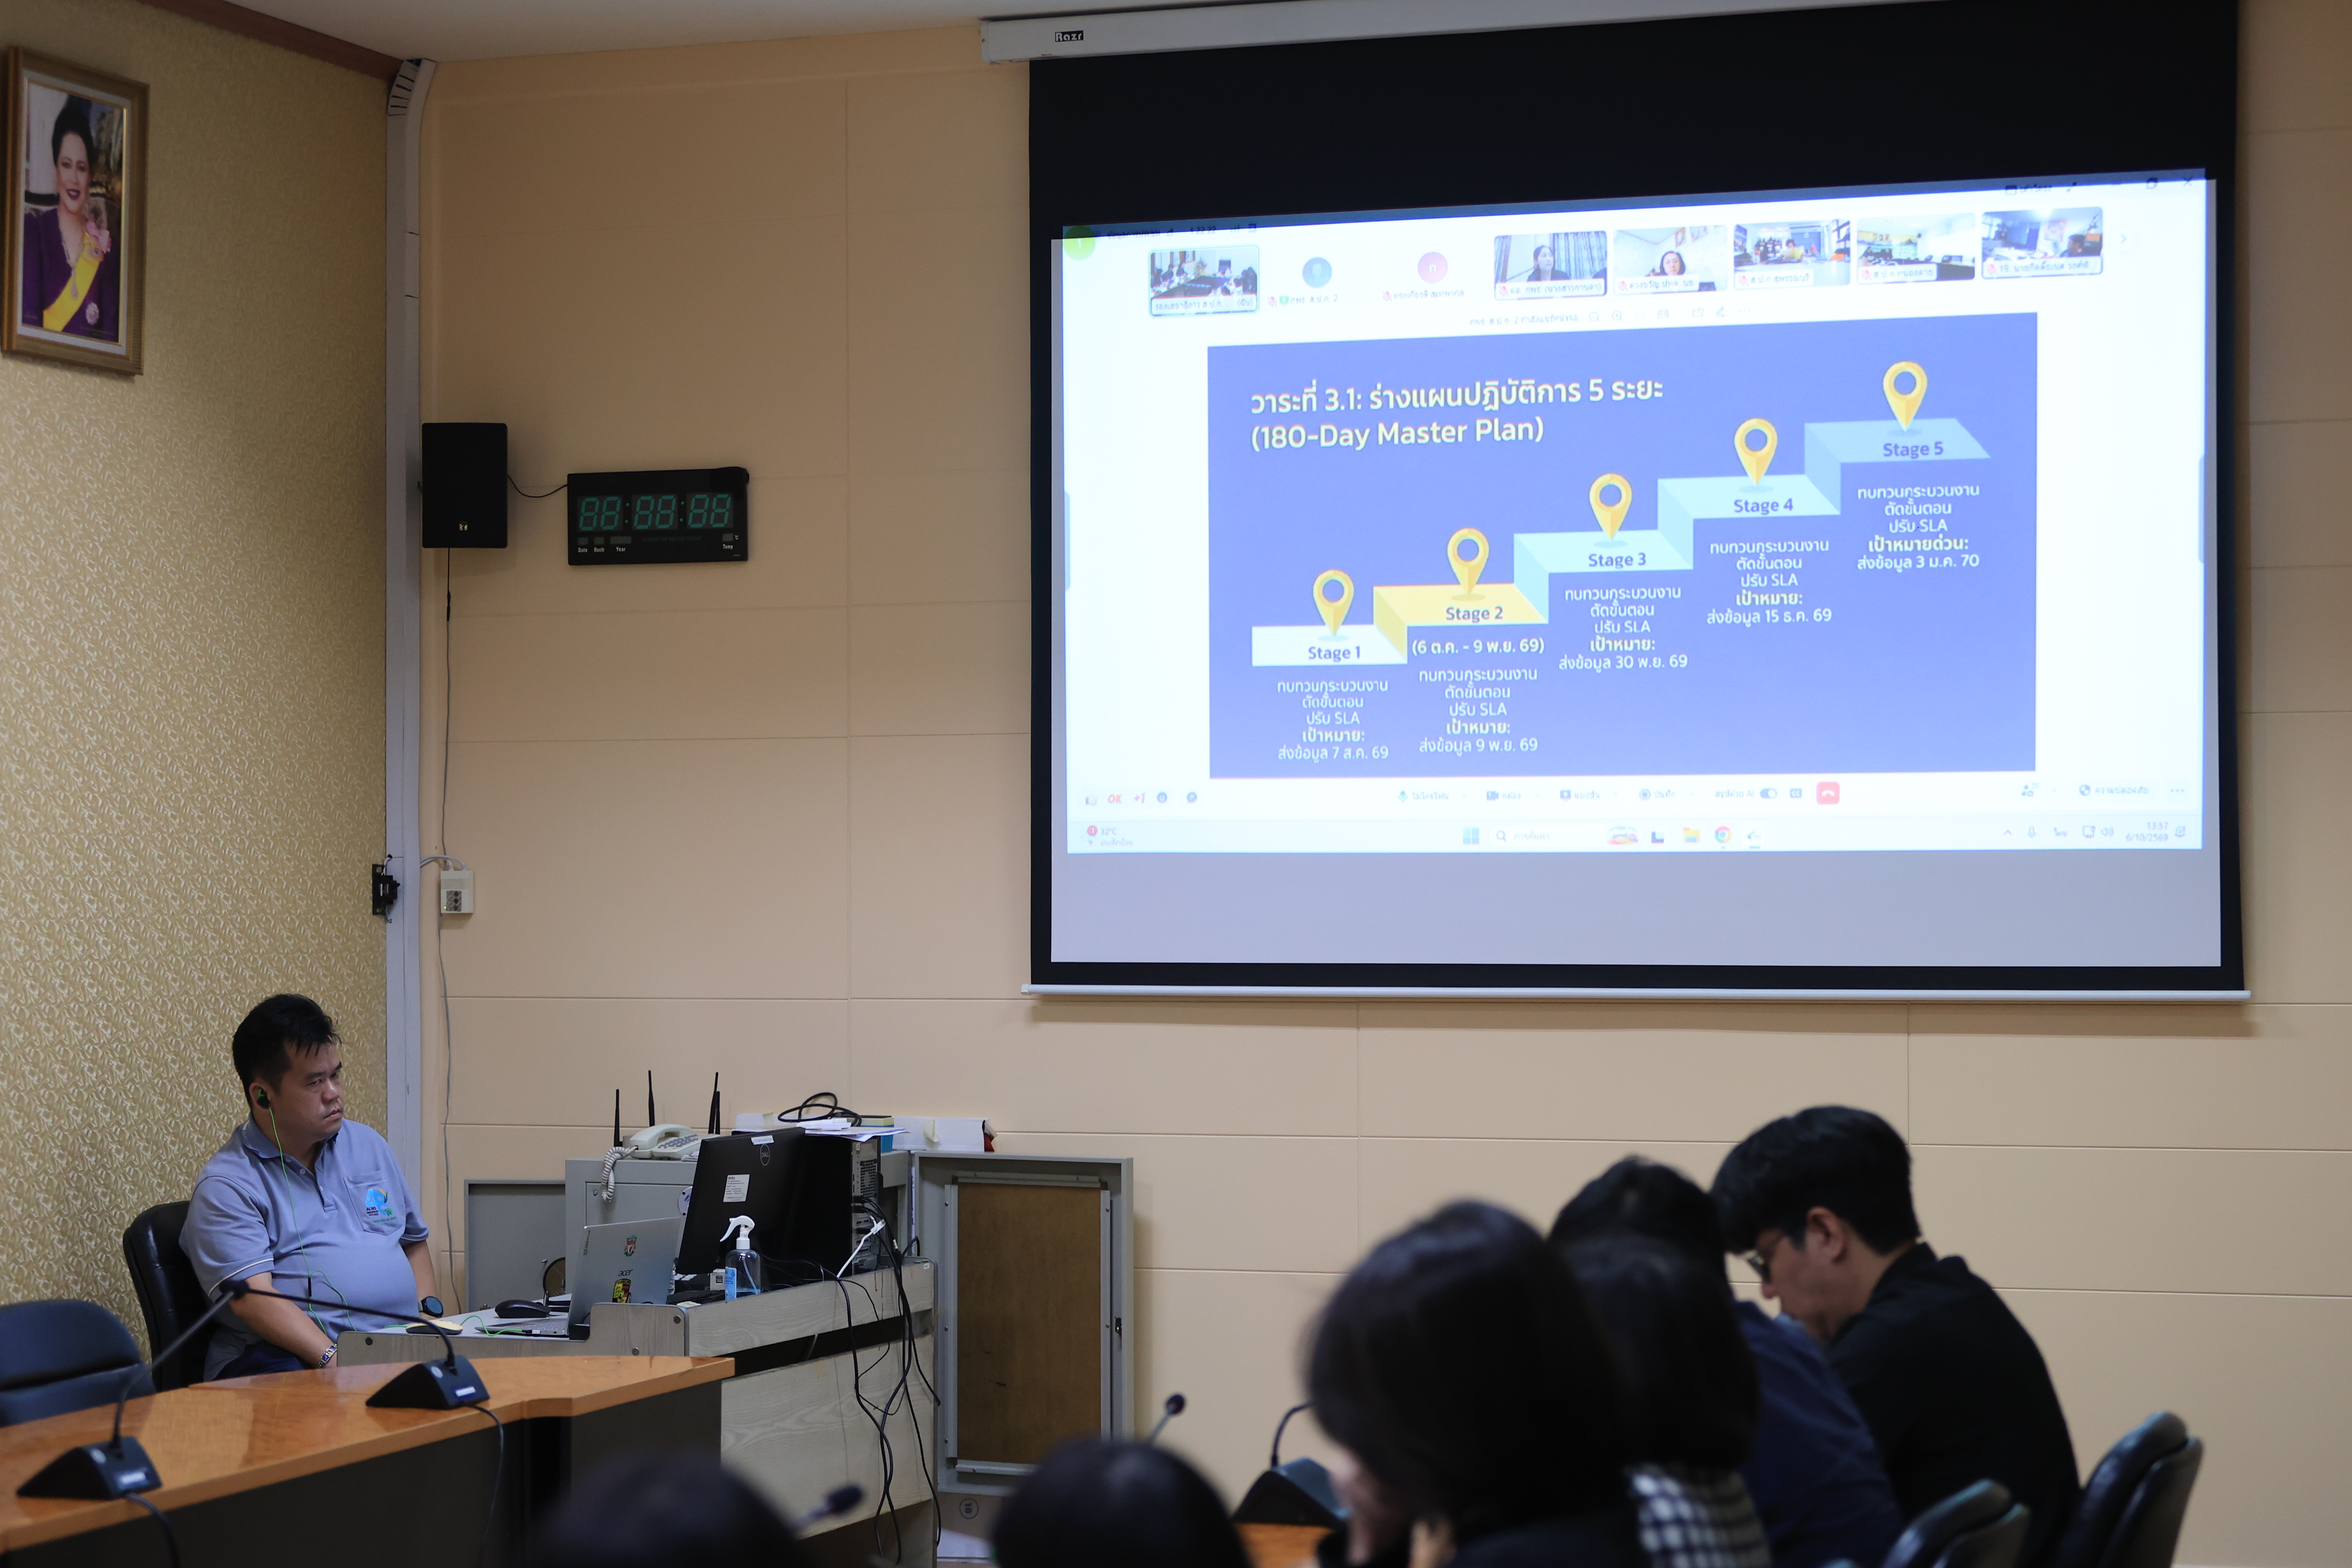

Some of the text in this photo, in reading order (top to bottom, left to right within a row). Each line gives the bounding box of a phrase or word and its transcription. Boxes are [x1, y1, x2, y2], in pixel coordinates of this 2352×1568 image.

[1055, 31, 1084, 42] Razr
[1251, 377, 1663, 413] วาระที่ 3.1: ร่างแผนปฏิบัติการ 5 ระยะ
[1252, 415, 1544, 452] (180-Day Master Plan)
[1883, 440, 1944, 460] Stage 5
[1857, 485, 1979, 499] ทบทวนกระบวนงาน
[1733, 497, 1794, 515] Stage 4
[1884, 497, 1952, 516] ตัดขั้นตอน
[1889, 518, 1948, 533] ปรับ SLA
[1709, 540, 1830, 554] ทบทวนกระบวนงาน
[1868, 533, 1968, 552] เป้าหมายด่วน:
[1588, 551, 1647, 569] Stage 3
[1736, 550, 1803, 570] ตัดขั้นตอน
[1857, 553, 1979, 573] ส่งข้อมูล 3 ม.ค. 70
[1740, 573, 1798, 587] ปรับ SLA
[1564, 587, 1682, 601] ทบทวนกระบวนงาน
[1736, 589, 1802, 606] เป้าหมาย:
[1446, 605, 1503, 623] Stage 2
[1590, 597, 1655, 618] ตัดขั้นตอน
[1595, 619, 1651, 633] ปรับ SLA
[1707, 607, 1832, 628] ส่งข้อมูล 15 ธ.ค. 69
[1412, 639, 1427, 656] (6
[1431, 641, 1459, 654] ต.ค.
[1473, 639, 1483, 653] 9
[1487, 640, 1516, 652] พ.ย.
[1519, 637, 1544, 654] 69)
[1590, 634, 1655, 651] เป้าหมาย:
[1308, 645, 1360, 662] Stage 1
[1559, 653, 1688, 673] ส่งข้อมูล 30 พ.ย. 69
[1419, 668, 1538, 682] ทบทวนกระบวนงาน
[1277, 679, 1389, 692] ทบทวนกระบวนงาน
[1444, 681, 1511, 699] ตัดขั้นตอน
[1301, 690, 1364, 709] ตัดขั้นตอน
[1306, 710, 1360, 725] ปรับ SLA
[1449, 701, 1507, 717] ปรับ SLA
[1302, 726, 1365, 741] เป้าหมาย:
[1446, 717, 1510, 734] เป้าหมาย:
[1278, 743, 1389, 763] ส่งข้อมูล 7 ส.ค. 69
[1419, 736, 1538, 756] ส่งข้อมูล 9 พ.ย. 69
[1107, 793, 1123, 804] OK
[2146, 821, 2169, 830] 13:57
[618, 1269, 633, 1277] acer
